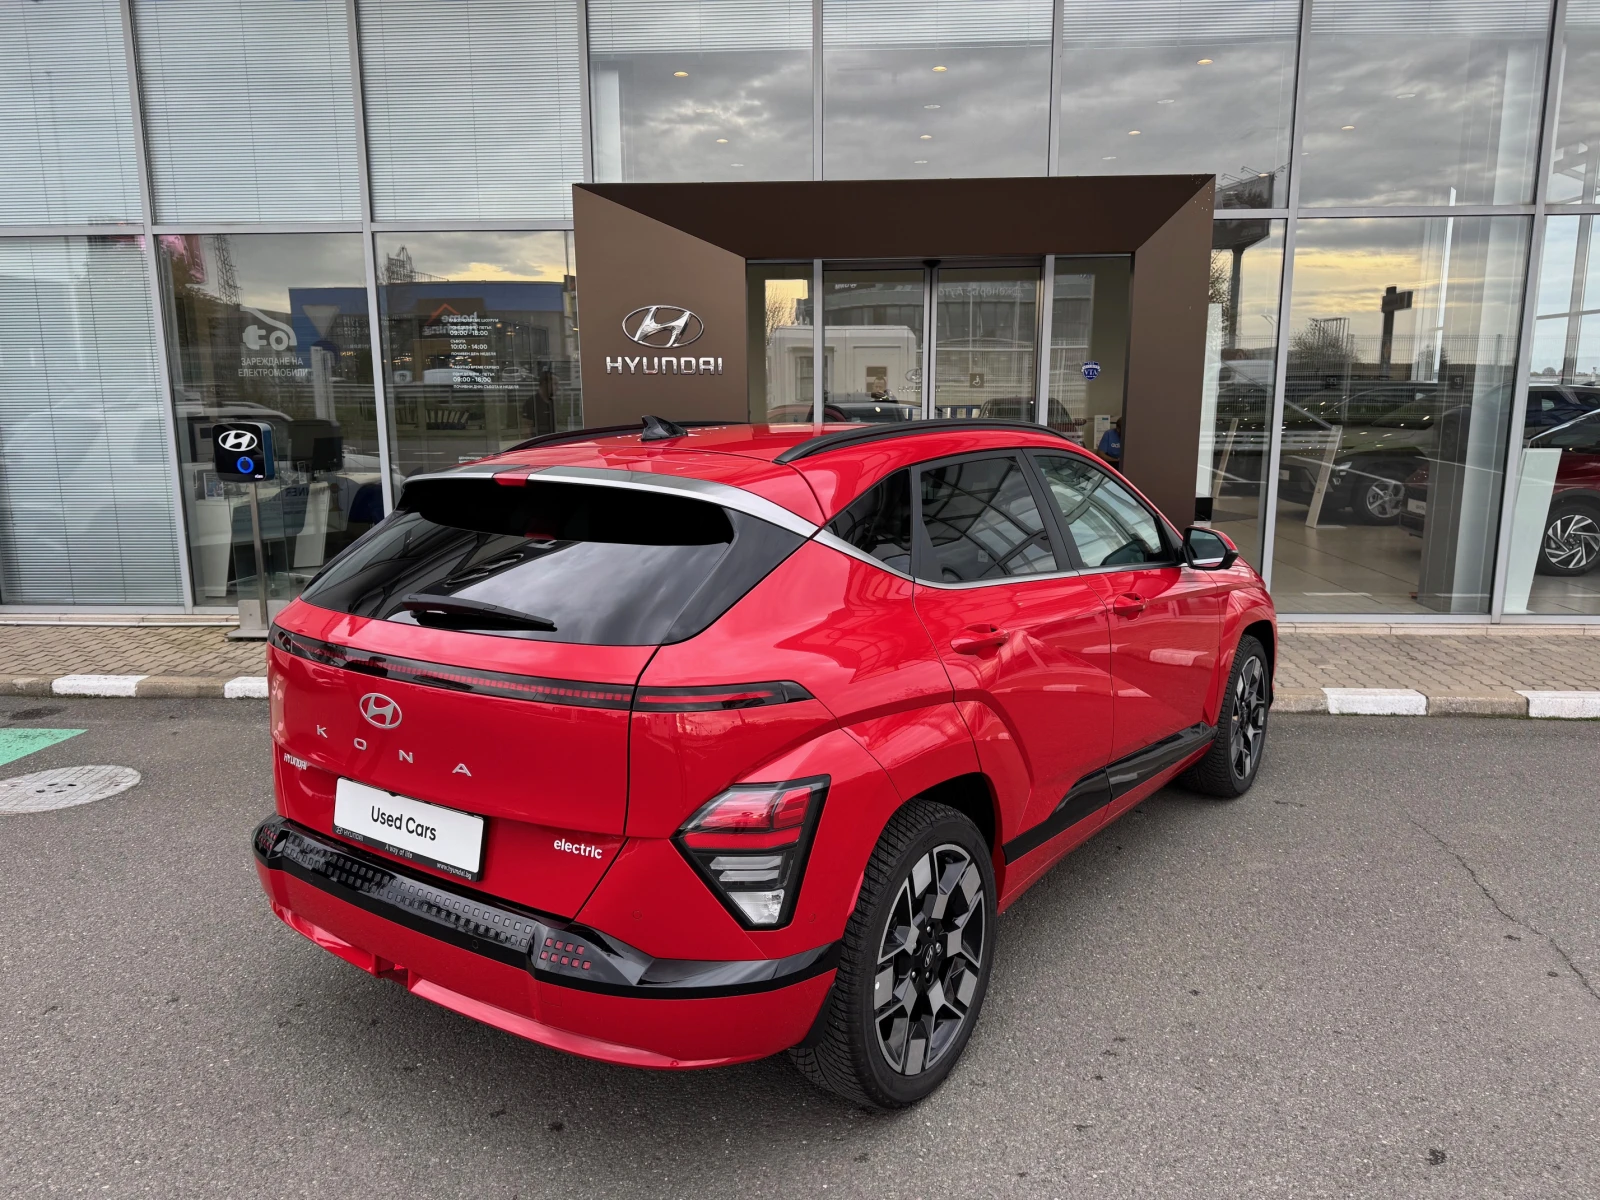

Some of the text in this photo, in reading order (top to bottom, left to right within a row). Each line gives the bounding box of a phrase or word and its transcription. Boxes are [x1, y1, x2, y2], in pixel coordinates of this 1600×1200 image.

[241, 357, 304, 367] ЗАРЕЖДАНЕ НА
[605, 356, 723, 375] HYUNDAI
[238, 368, 309, 377] ЕЛЕКТРОМОБИЛИ
[316, 724, 472, 778] KONA
[283, 752, 308, 771] HYUNDAI
[371, 805, 437, 842] Used Cars
[343, 829, 364, 842] HYUNDAI
[389, 846, 399, 856] way
[404, 850, 413, 859] life
[553, 838, 603, 860] electric
[436, 862, 472, 880] www.hyundai.bg
